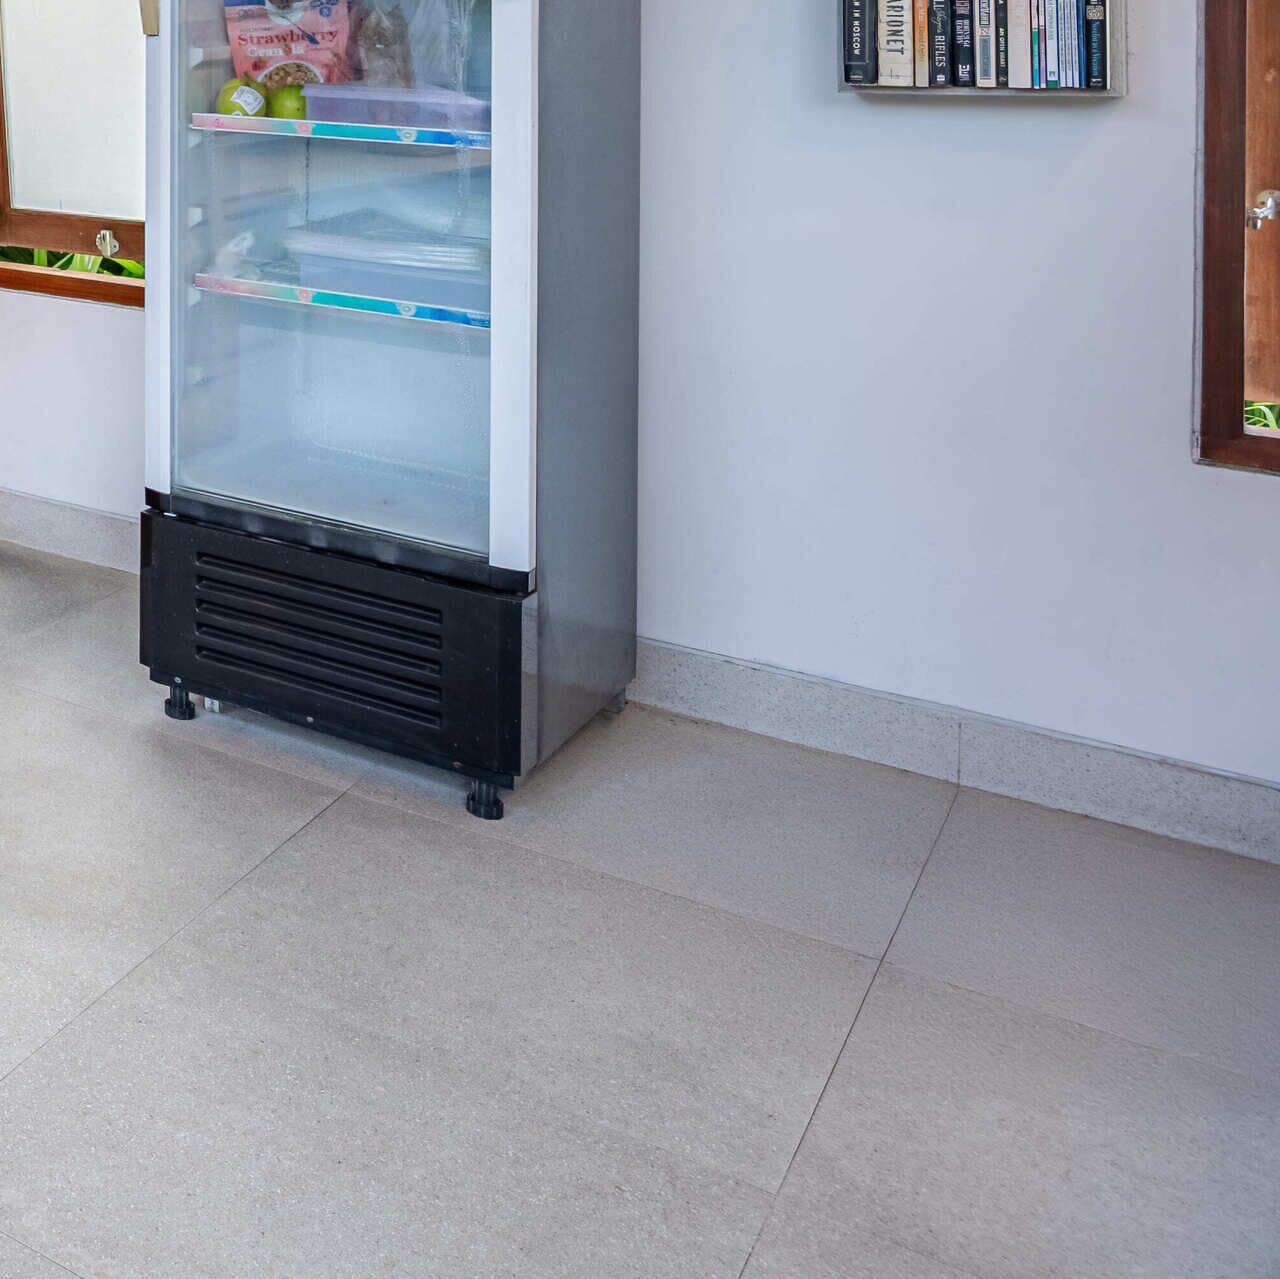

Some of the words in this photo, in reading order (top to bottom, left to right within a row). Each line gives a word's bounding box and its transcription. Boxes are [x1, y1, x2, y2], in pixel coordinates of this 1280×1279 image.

[238, 29, 338, 46] Strawbry
[852, 21, 861, 56] MOSCOW
[935, 35, 946, 67] RIFLES
